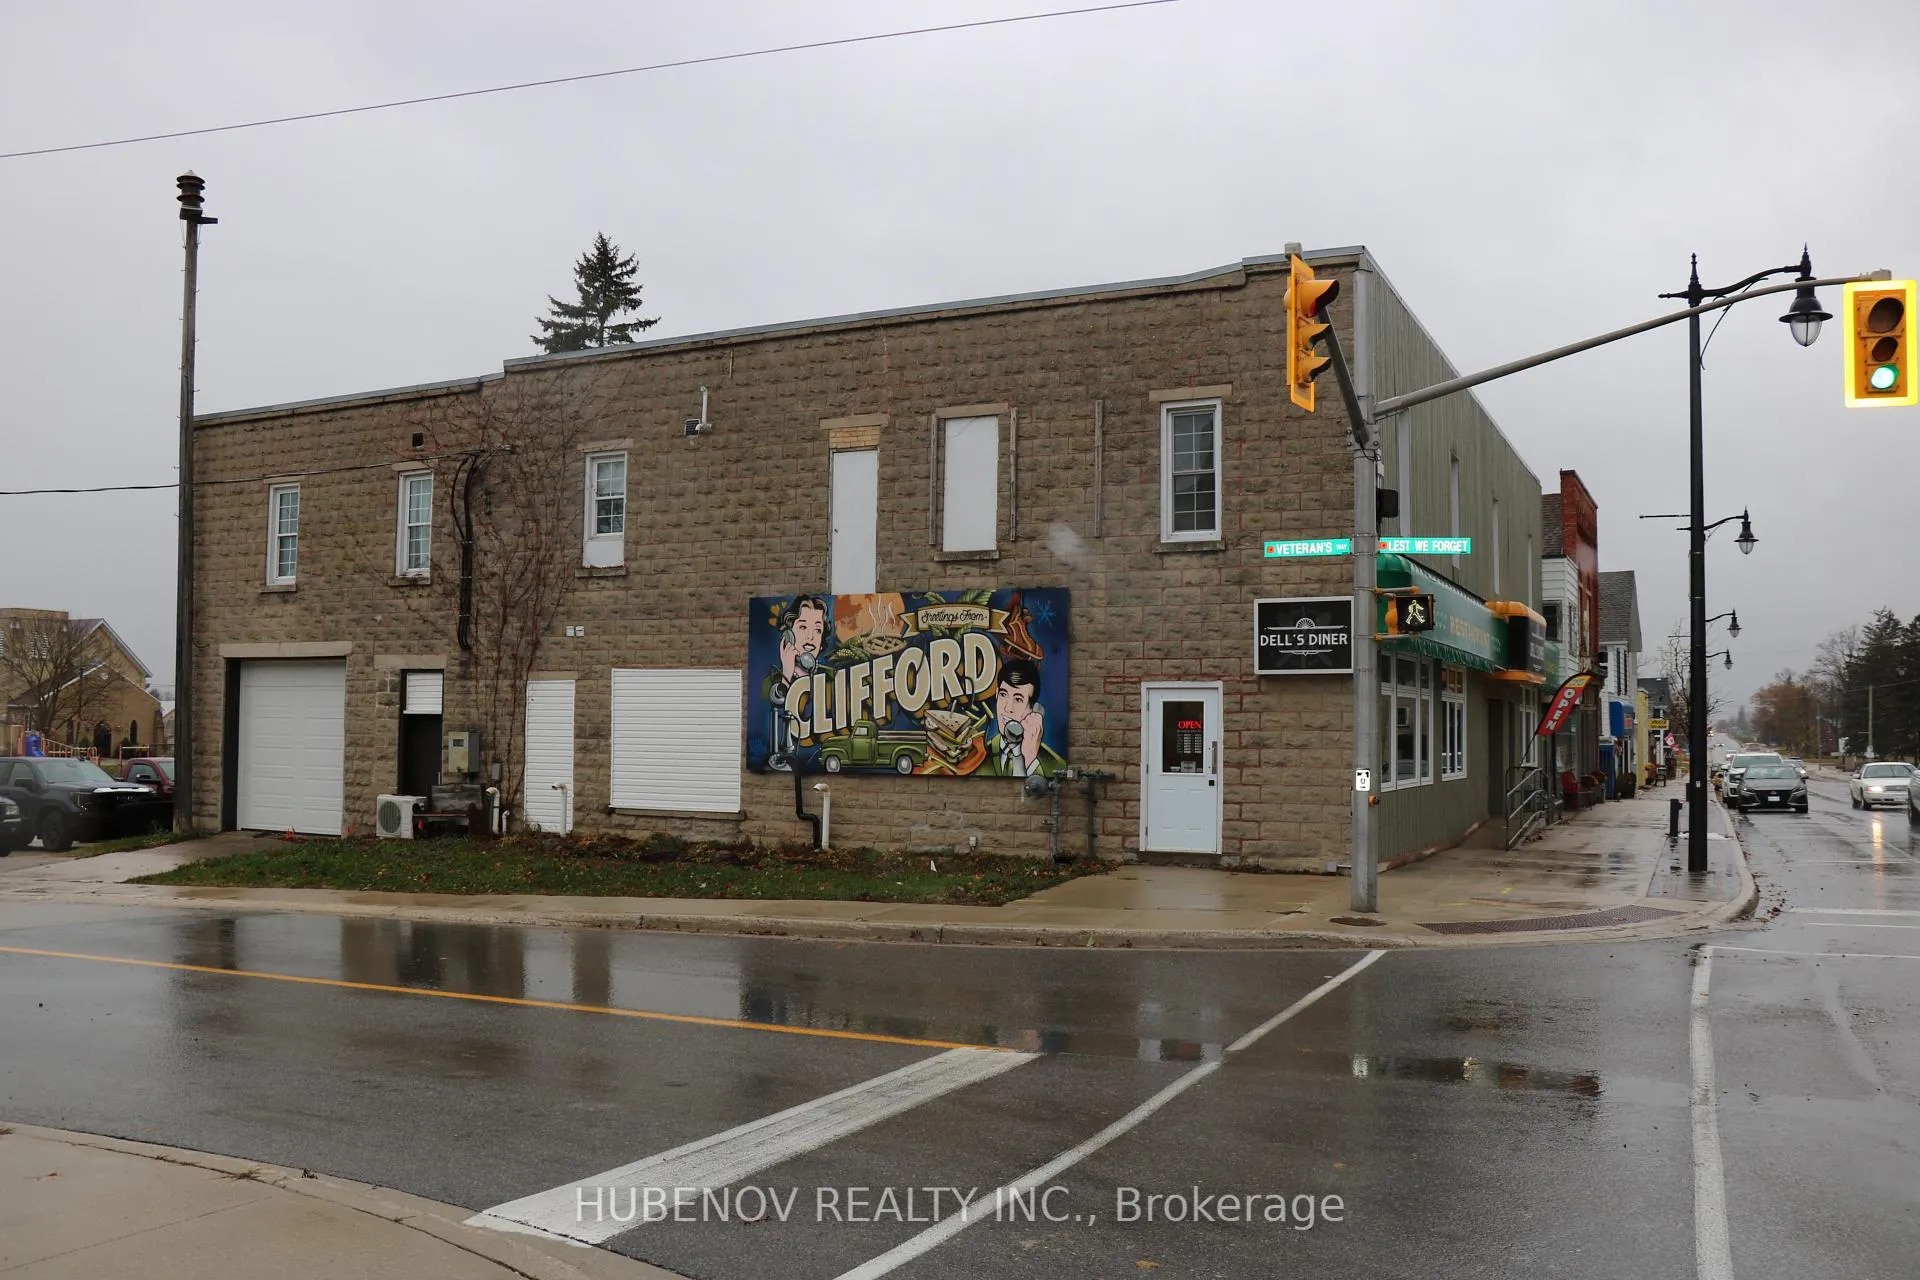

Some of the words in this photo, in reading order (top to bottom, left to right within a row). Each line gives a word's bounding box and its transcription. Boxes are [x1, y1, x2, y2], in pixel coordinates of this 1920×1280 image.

[1275, 540, 1333, 555] VETERAN'S
[1335, 543, 1348, 551] WAY
[1388, 540, 1411, 552] LEST
[1414, 540, 1429, 552] WE
[1431, 540, 1468, 552] FORGET
[921, 608, 959, 628] Greetings
[959, 608, 985, 622] From
[1260, 633, 1305, 647] DELL'S
[1308, 633, 1348, 646] DINER
[784, 632, 998, 740] CLIFFORD
[1545, 688, 1576, 730] OPEN
[1178, 720, 1201, 729] OPEN
